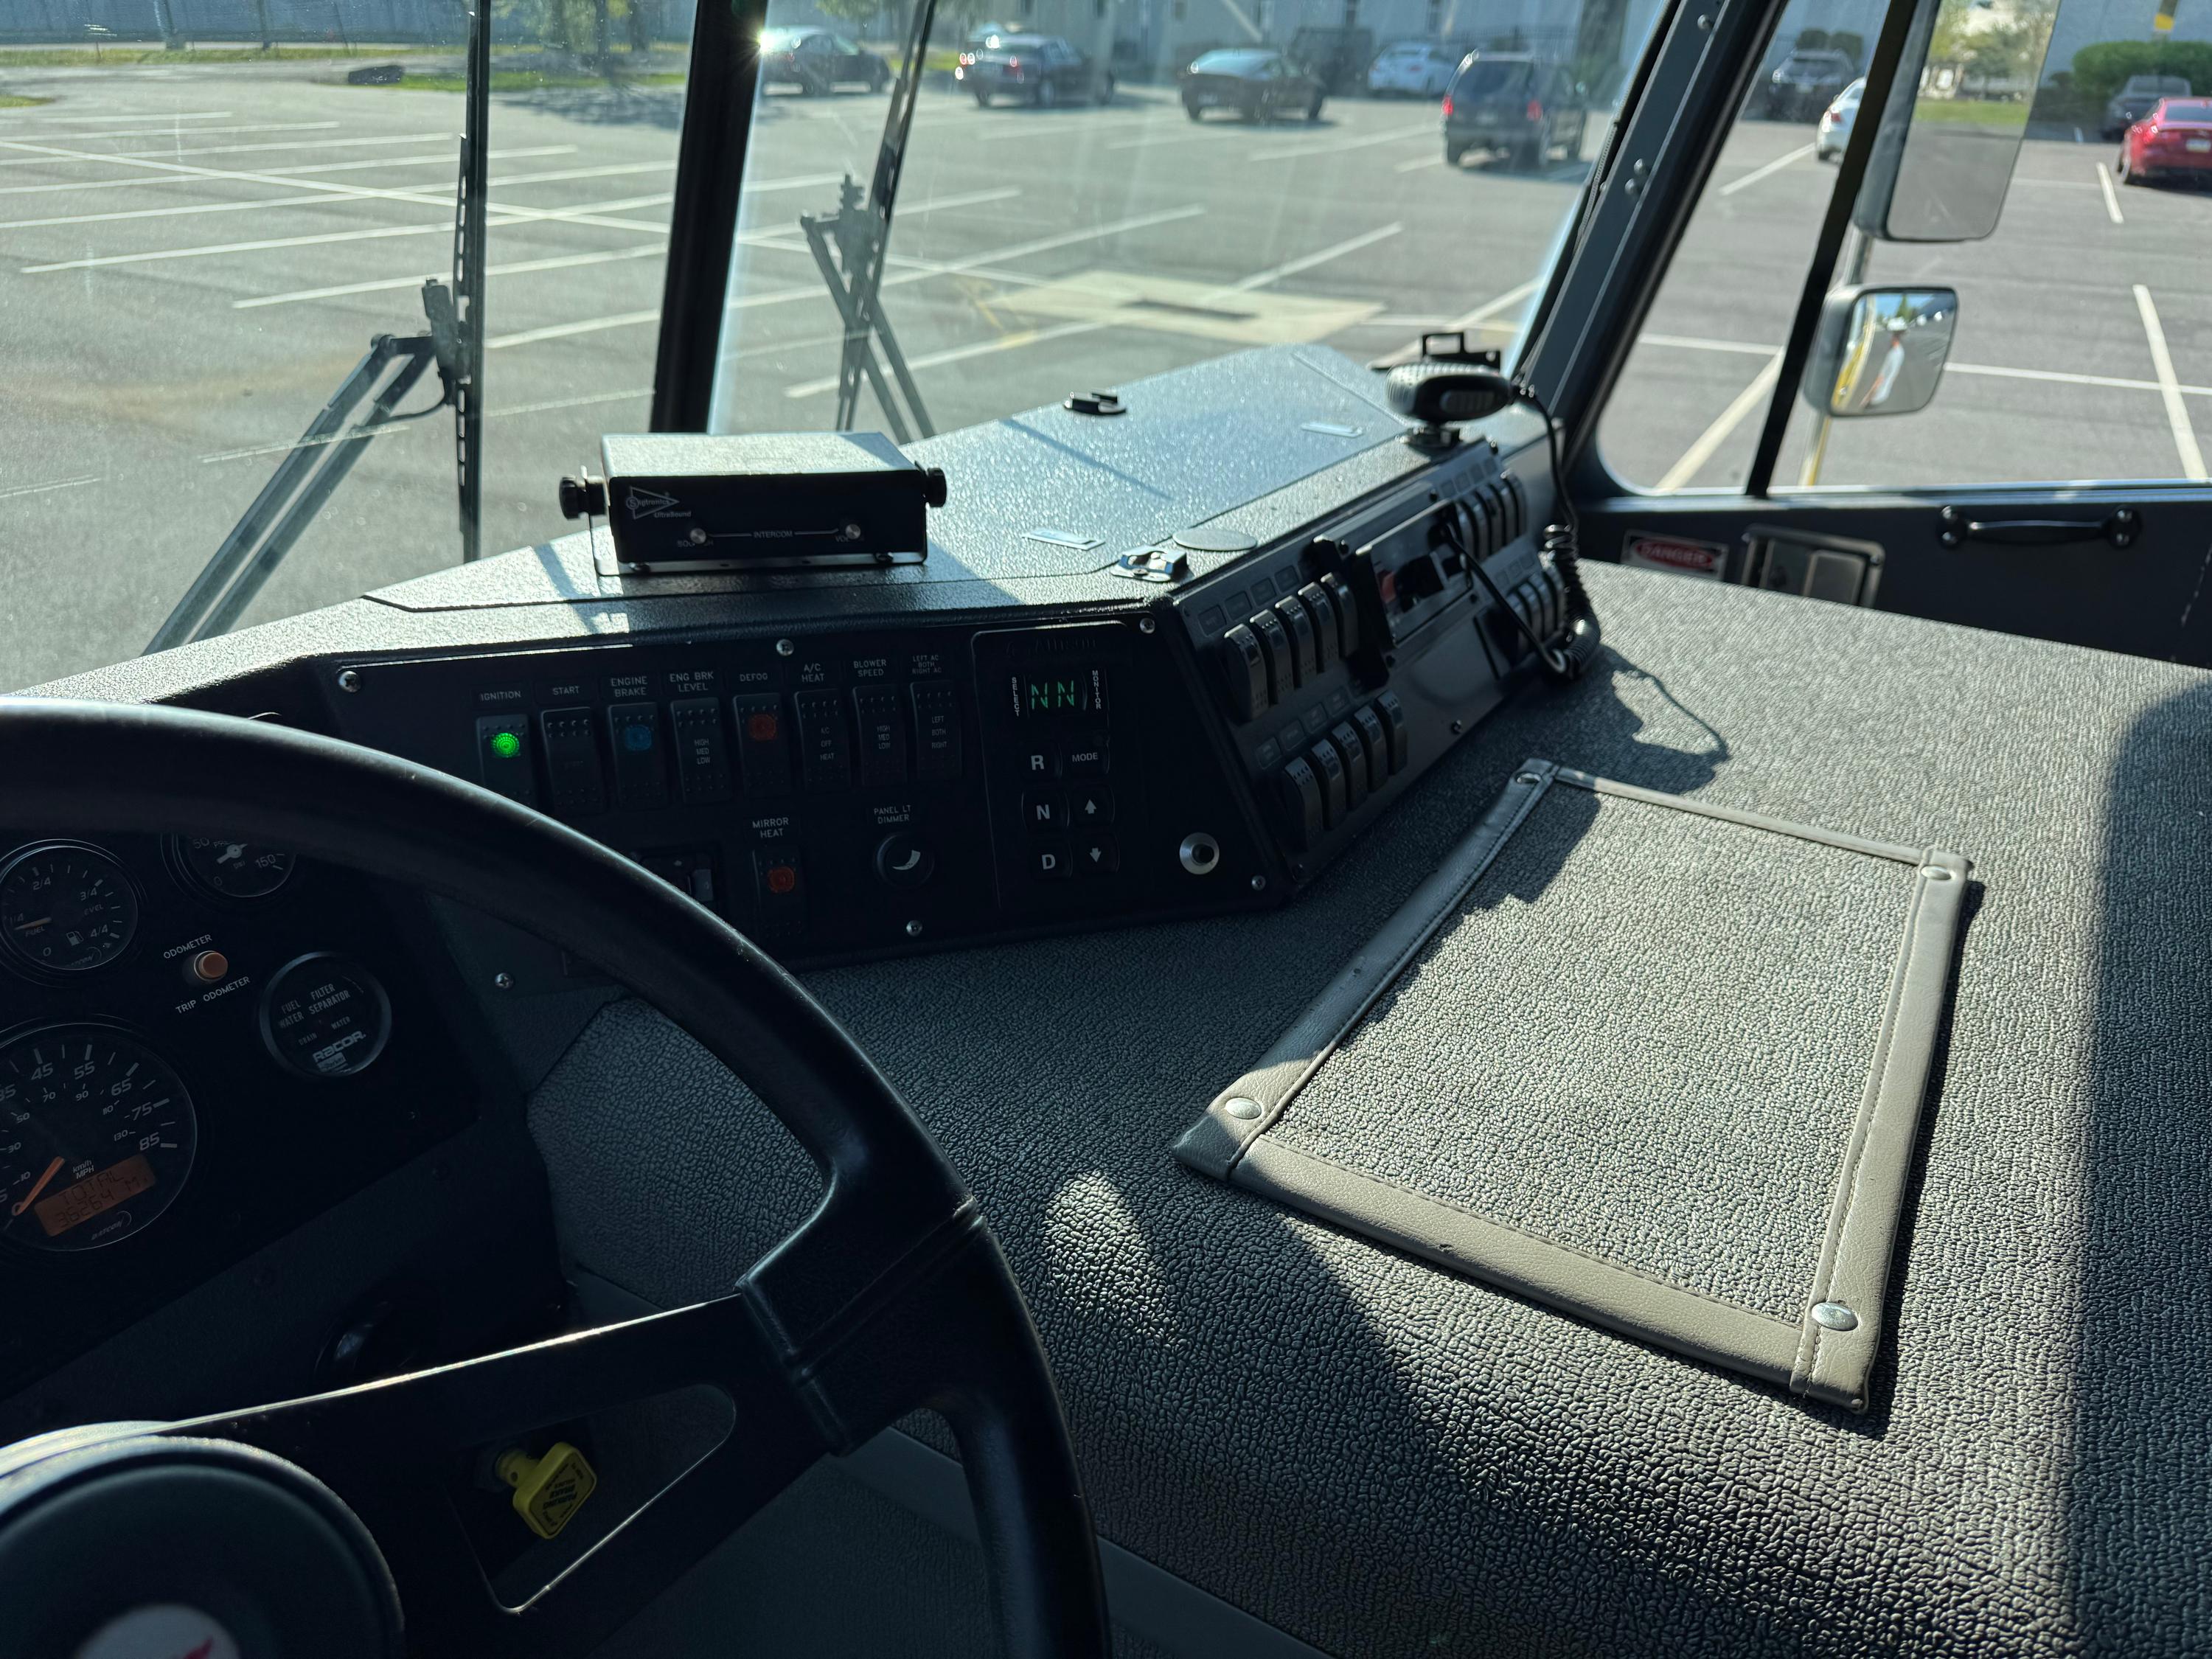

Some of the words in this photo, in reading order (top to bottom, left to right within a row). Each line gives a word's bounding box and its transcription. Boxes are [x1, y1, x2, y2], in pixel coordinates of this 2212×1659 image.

[753, 531, 793, 539] INTERCOM
[804, 663, 821, 672] A/C
[853, 658, 886, 669] BLOWER
[669, 672, 689, 683] ENG
[695, 670, 714, 680] BRK
[739, 672, 768, 682] DEFOG
[801, 672, 825, 683] HEAT
[857, 668, 884, 678] SPEED
[611, 675, 647, 686] ENGINE
[552, 685, 580, 696] START
[614, 687, 647, 698] BRAKE
[678, 682, 709, 692] LEVEL
[1092, 669, 1102, 709] MONITOR
[480, 690, 521, 701] IGNITION
[1012, 676, 1020, 717] SELECT
[931, 716, 945, 724] LEFT
[878, 733, 890, 741] MED
[932, 728, 946, 737] BOTH
[694, 738, 709, 748] HIGH
[821, 740, 832, 748] OFF
[878, 741, 891, 749] LOW
[931, 741, 947, 749] RIGHT
[695, 747, 709, 755] MED
[696, 756, 712, 765] LOW
[820, 753, 835, 761] HEAT
[1072, 752, 1098, 762] MODE
[1031, 755, 1045, 771] R
[1036, 804, 1050, 820] N
[752, 817, 790, 829] MIRROR
[877, 814, 909, 824] DIMMER
[759, 828, 785, 838] HEAT
[193, 838, 209, 849] 50
[255, 854, 276, 868] 150
[1041, 854, 1056, 870] D
[32, 877, 51, 891] 2/4
[80, 887, 97, 901] 3/4
[25, 926, 45, 938] FUEL
[91, 925, 108, 937] 4/4
[43, 947, 52, 956] 0
[163, 934, 212, 959] ODOMETER
[175, 1000, 196, 1014] TRIP
[203, 976, 251, 1001] ODOMETER
[281, 999, 301, 1014] FUEL
[310, 984, 335, 1001] FILTER
[279, 1012, 305, 1029] WATER
[308, 990, 351, 1015] SEPARATOR
[298, 1032, 317, 1046] DRAIN
[331, 1016, 351, 1030] WATER
[31, 1062, 54, 1080] 45
[74, 1061, 95, 1079] 55
[111, 1078, 132, 1096] 65
[43, 1091, 56, 1102] 70
[76, 1091, 89, 1102] 90
[102, 1105, 114, 1115] 110
[132, 1102, 153, 1121] 75
[16, 1113, 30, 1124] 50
[114, 1130, 128, 1141] 130
[139, 1132, 160, 1151] 85
[7, 1141, 22, 1154] 30
[72, 1159, 91, 1172] km/h
[21, 1171, 31, 1181] 10
[76, 1165, 94, 1179] MPH
[63, 1171, 124, 1205] TOTAL
